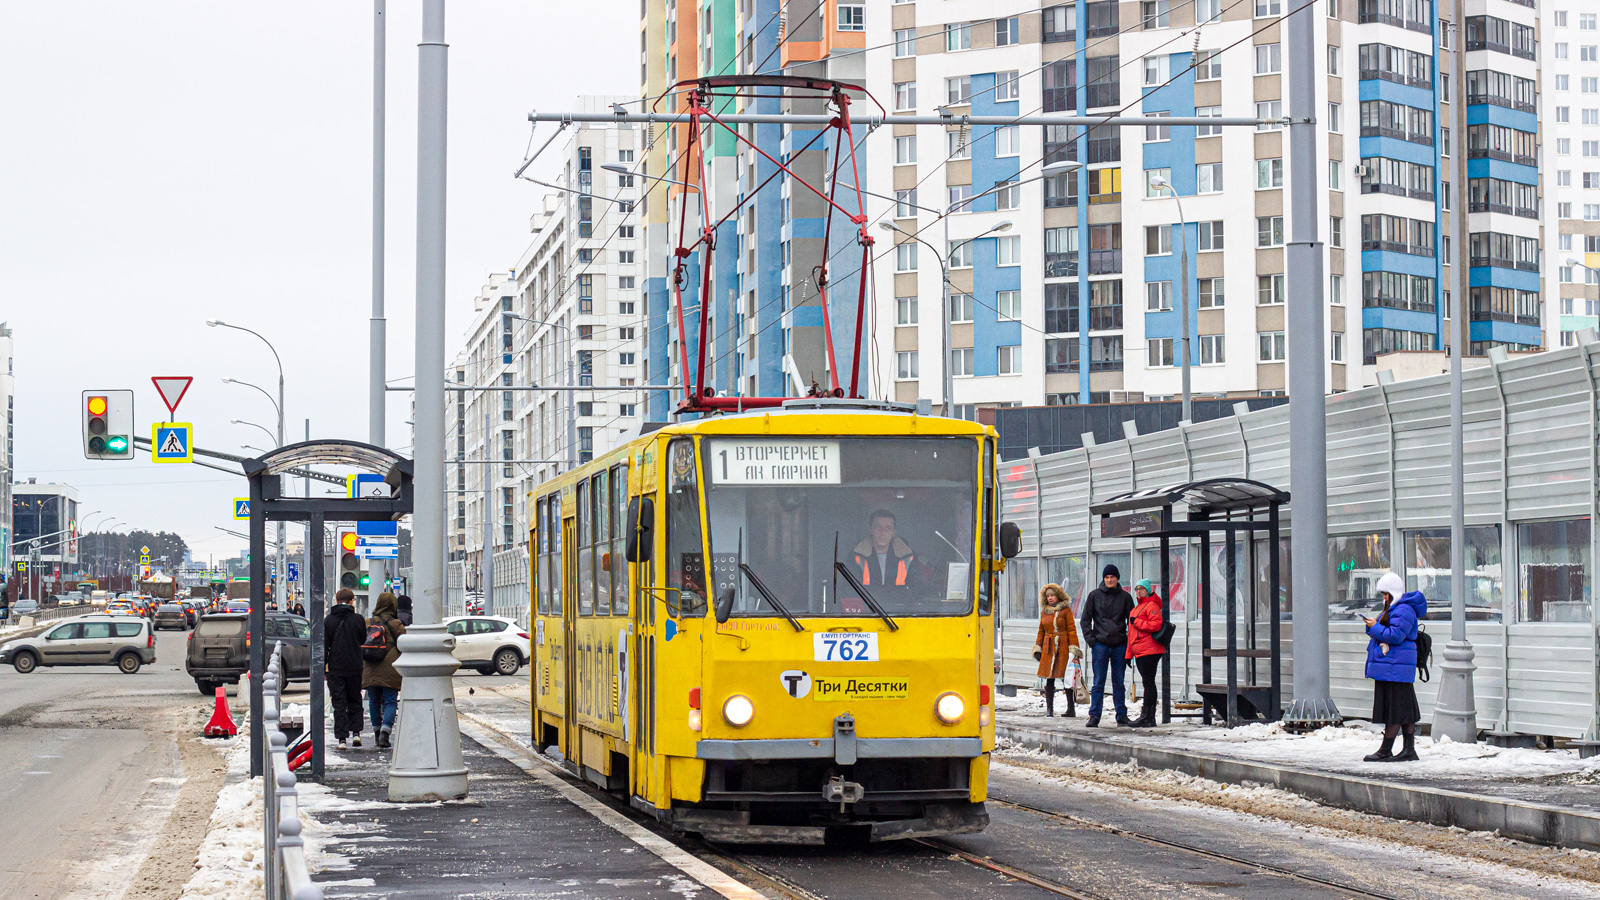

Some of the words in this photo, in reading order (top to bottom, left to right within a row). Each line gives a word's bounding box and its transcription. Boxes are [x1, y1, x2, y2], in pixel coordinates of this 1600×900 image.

[736, 446, 828, 460] ВТОРЧЕРМЕТ
[719, 449, 728, 480] 1
[771, 465, 828, 480] ПАРИНА
[823, 640, 869, 661] 762
[815, 680, 841, 694] Три
[845, 680, 908, 694] Десятки
